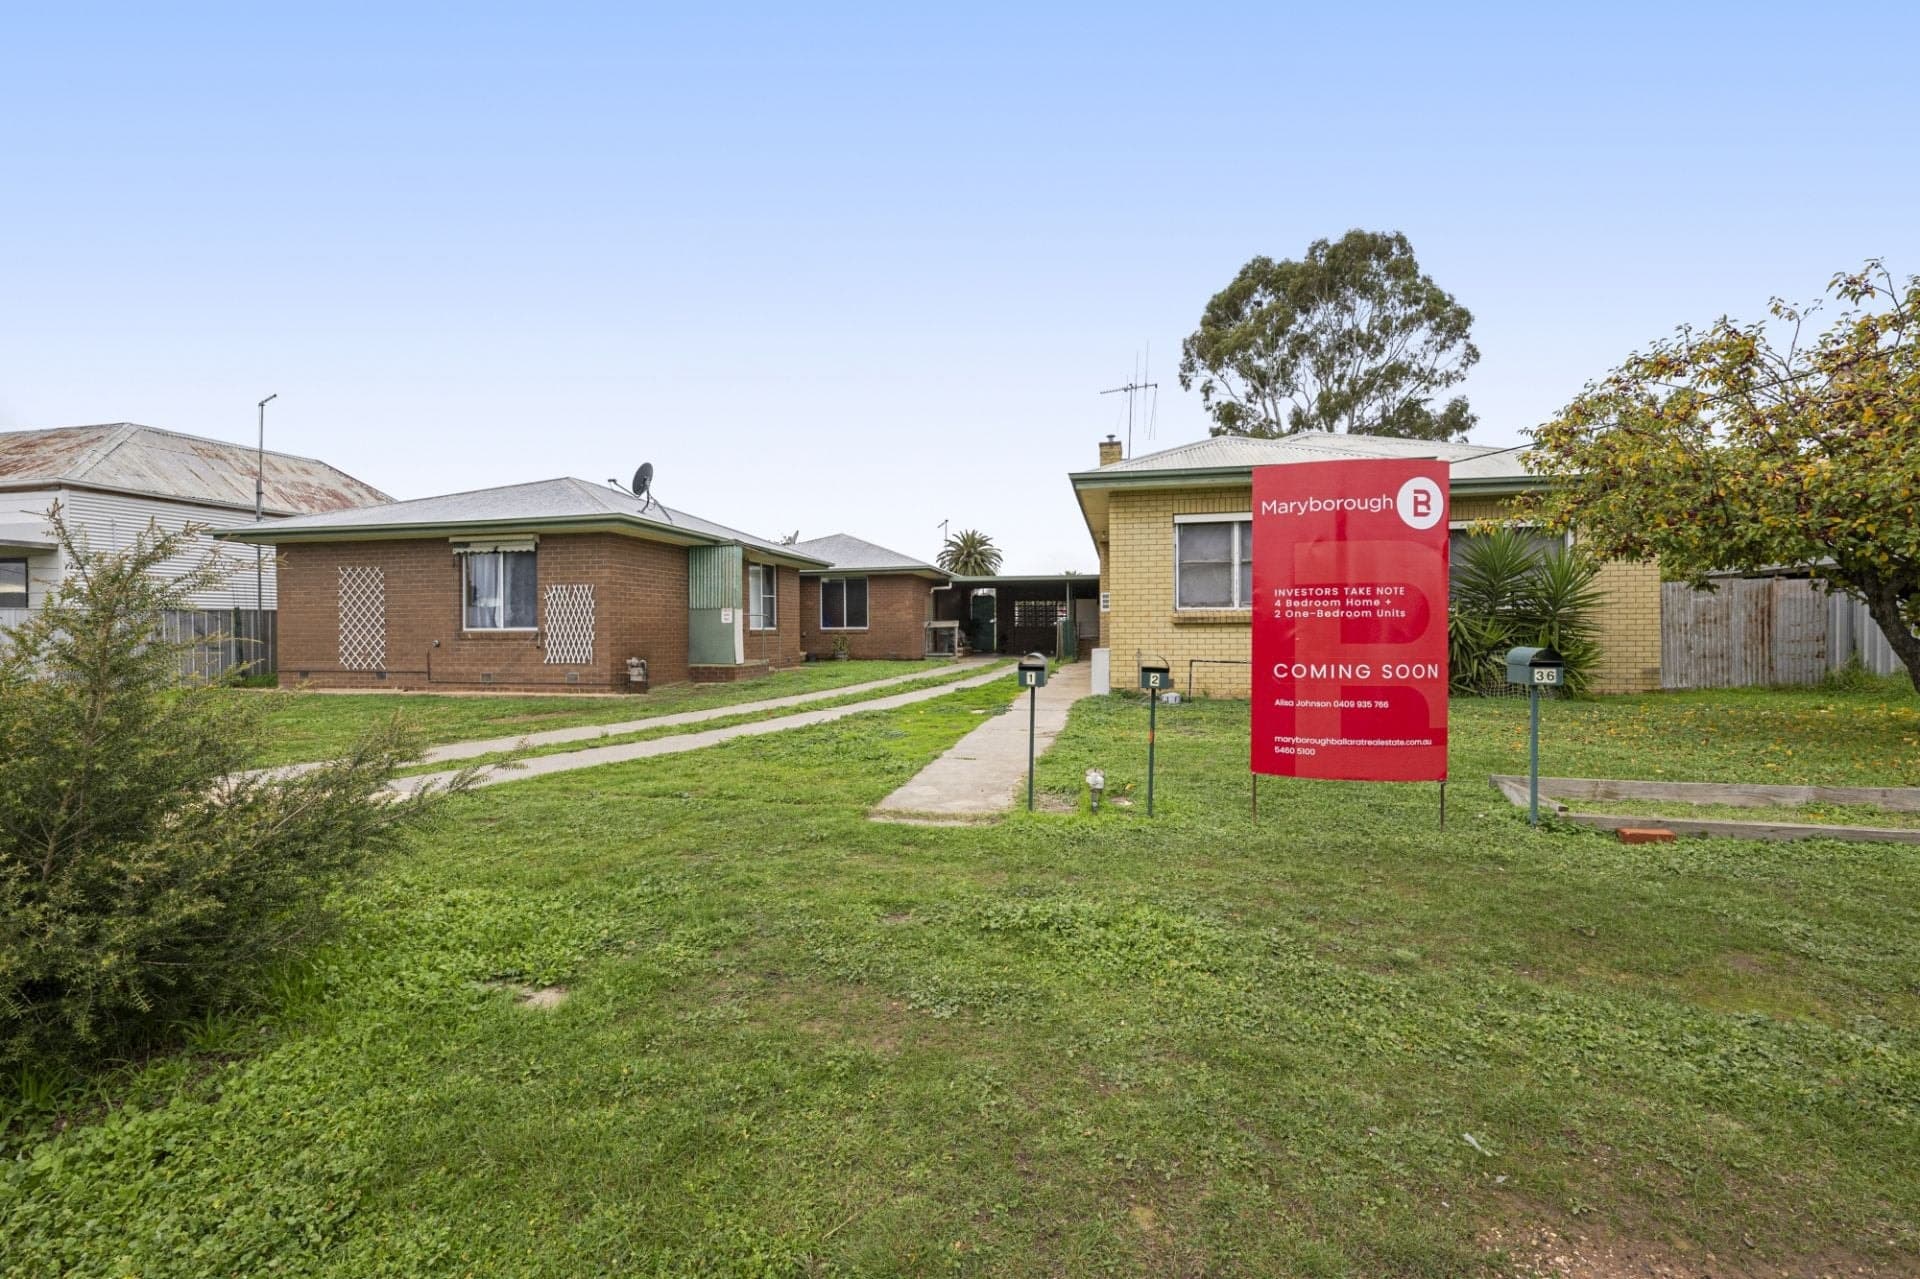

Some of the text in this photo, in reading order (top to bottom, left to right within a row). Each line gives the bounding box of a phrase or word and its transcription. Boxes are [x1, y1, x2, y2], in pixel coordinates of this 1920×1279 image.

[1261, 493, 1394, 516] Maryborough
[1413, 489, 1432, 518] B
[1274, 586, 1405, 597] INVESTORS TAKE NOTE
[1274, 600, 1281, 608] 4
[1285, 599, 1341, 608] Bedroom
[1346, 598, 1381, 607] Home
[1274, 608, 1406, 618] 2 One-Bedroom Units
[1273, 663, 1439, 680] COMING SOON
[1536, 670, 1555, 681] 36
[1151, 675, 1159, 685] 2
[1296, 699, 1332, 708] Johnson
